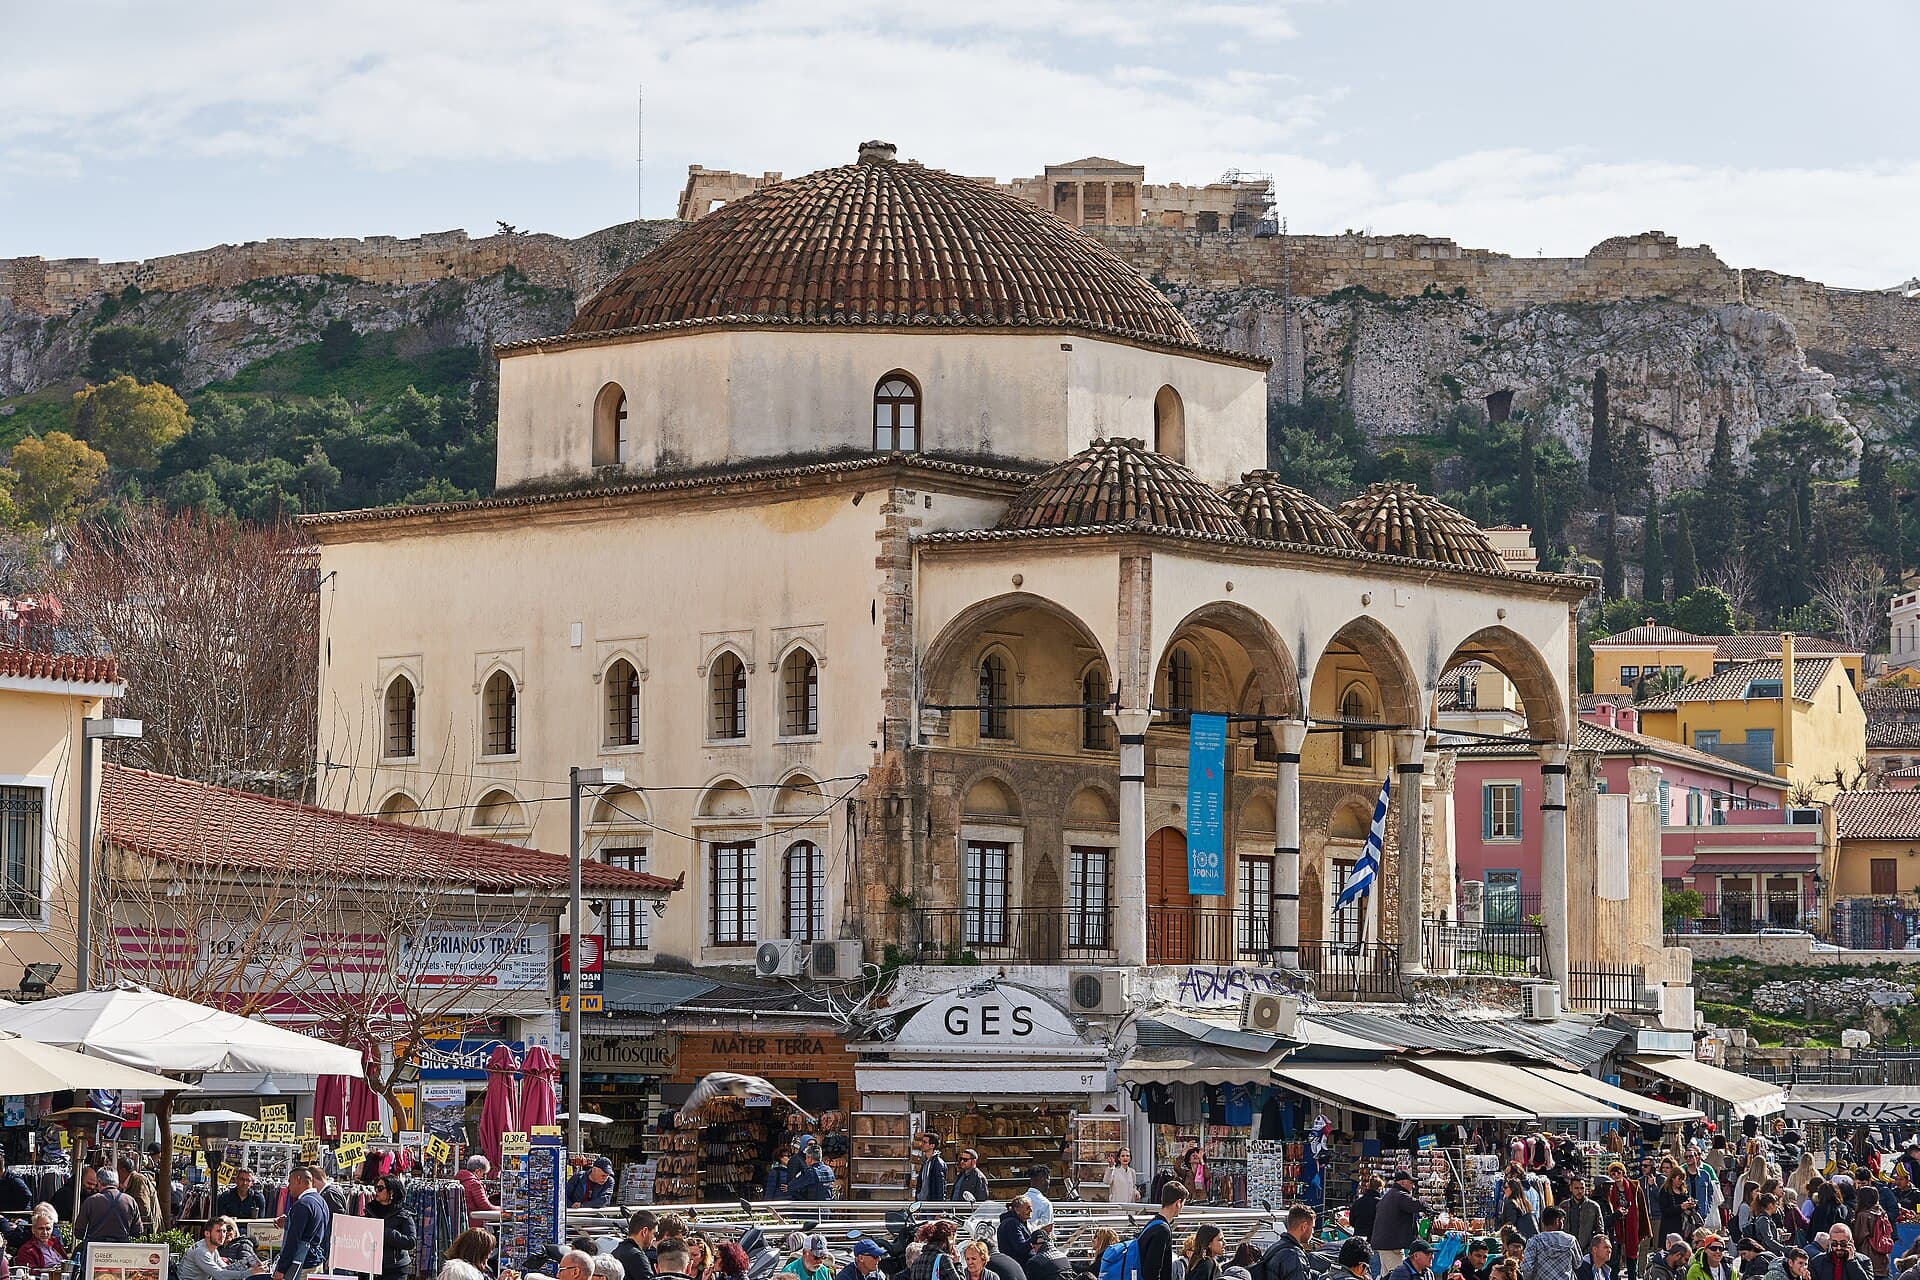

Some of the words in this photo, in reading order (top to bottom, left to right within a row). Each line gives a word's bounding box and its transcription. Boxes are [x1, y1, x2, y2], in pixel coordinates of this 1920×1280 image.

[424, 936, 485, 954] ADRIANOS
[490, 937, 533, 955] TRAVEL
[416, 961, 440, 970] ickets
[445, 961, 464, 972] Fery
[563, 973, 601, 981] MOAN
[944, 1005, 1034, 1037] GES
[711, 1038, 766, 1055] MATER
[775, 1038, 824, 1055] TERRA
[421, 1051, 449, 1069] Blue
[452, 1051, 478, 1070] Star
[607, 1046, 670, 1066] mosque
[728, 1060, 761, 1070] Handmade
[763, 1060, 787, 1070] Leather
[790, 1061, 815, 1070] Sandals
[1080, 1075, 1094, 1086] 97
[262, 1106, 286, 1118] 1.00€
[242, 1121, 265, 1134] 2.50€
[269, 1123, 295, 1134] 2.50€
[504, 1134, 526, 1145] 0,30€
